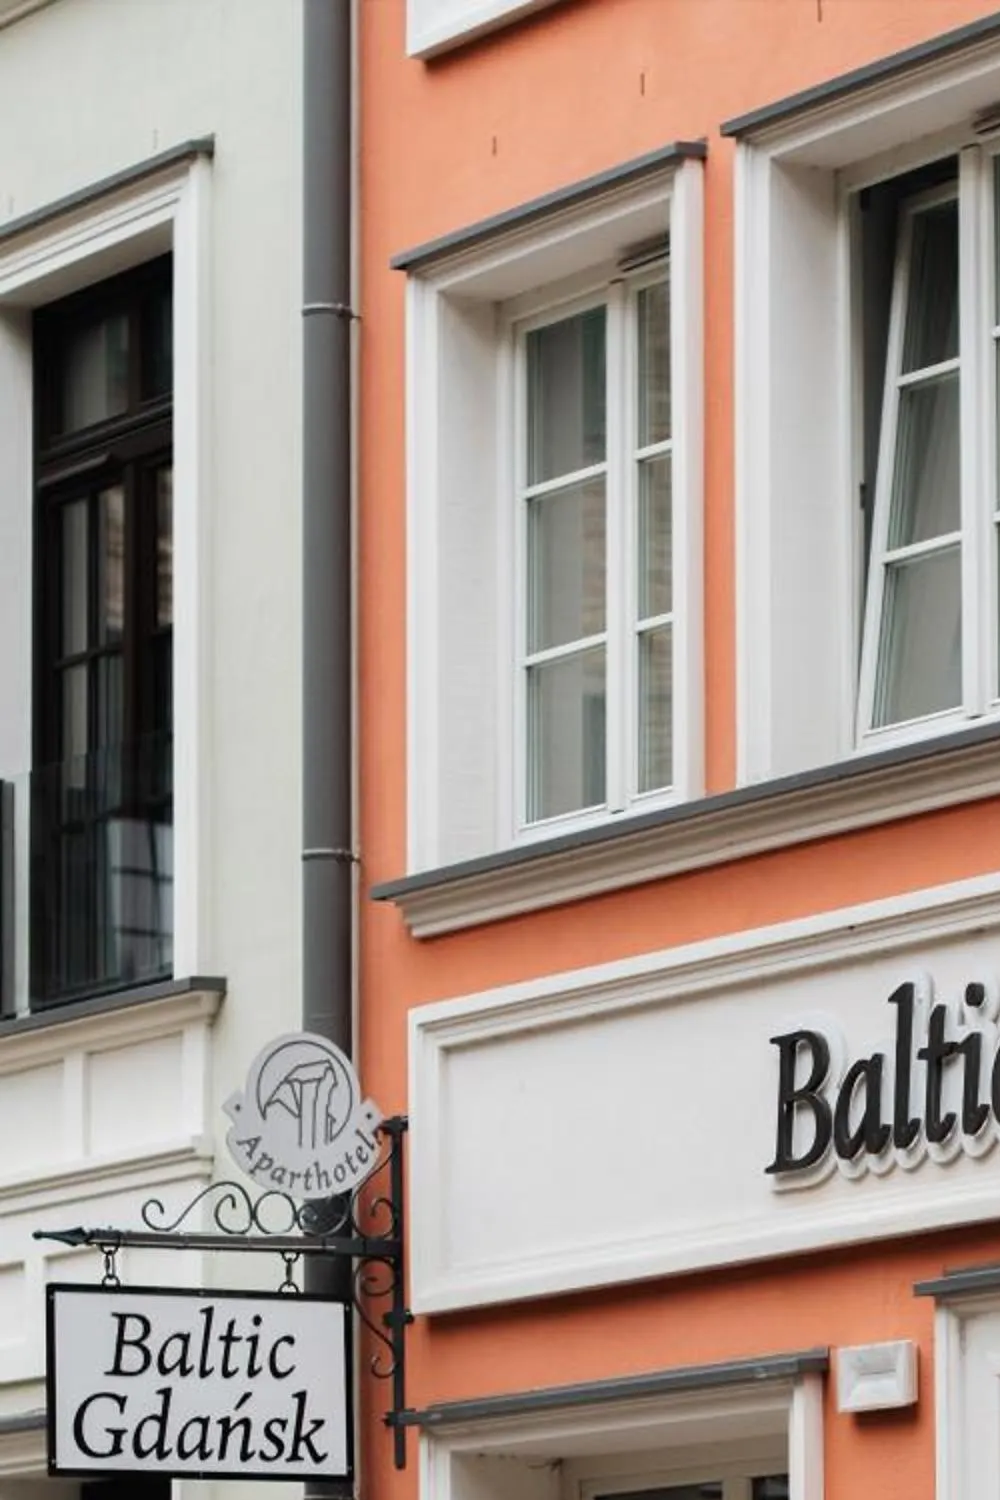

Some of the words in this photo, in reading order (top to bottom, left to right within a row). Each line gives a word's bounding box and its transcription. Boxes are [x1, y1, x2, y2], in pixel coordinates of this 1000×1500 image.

[235, 1128, 377, 1192] Aparthotel
[103, 1306, 298, 1381] Baltic
[71, 1387, 330, 1465] Gdańsk
